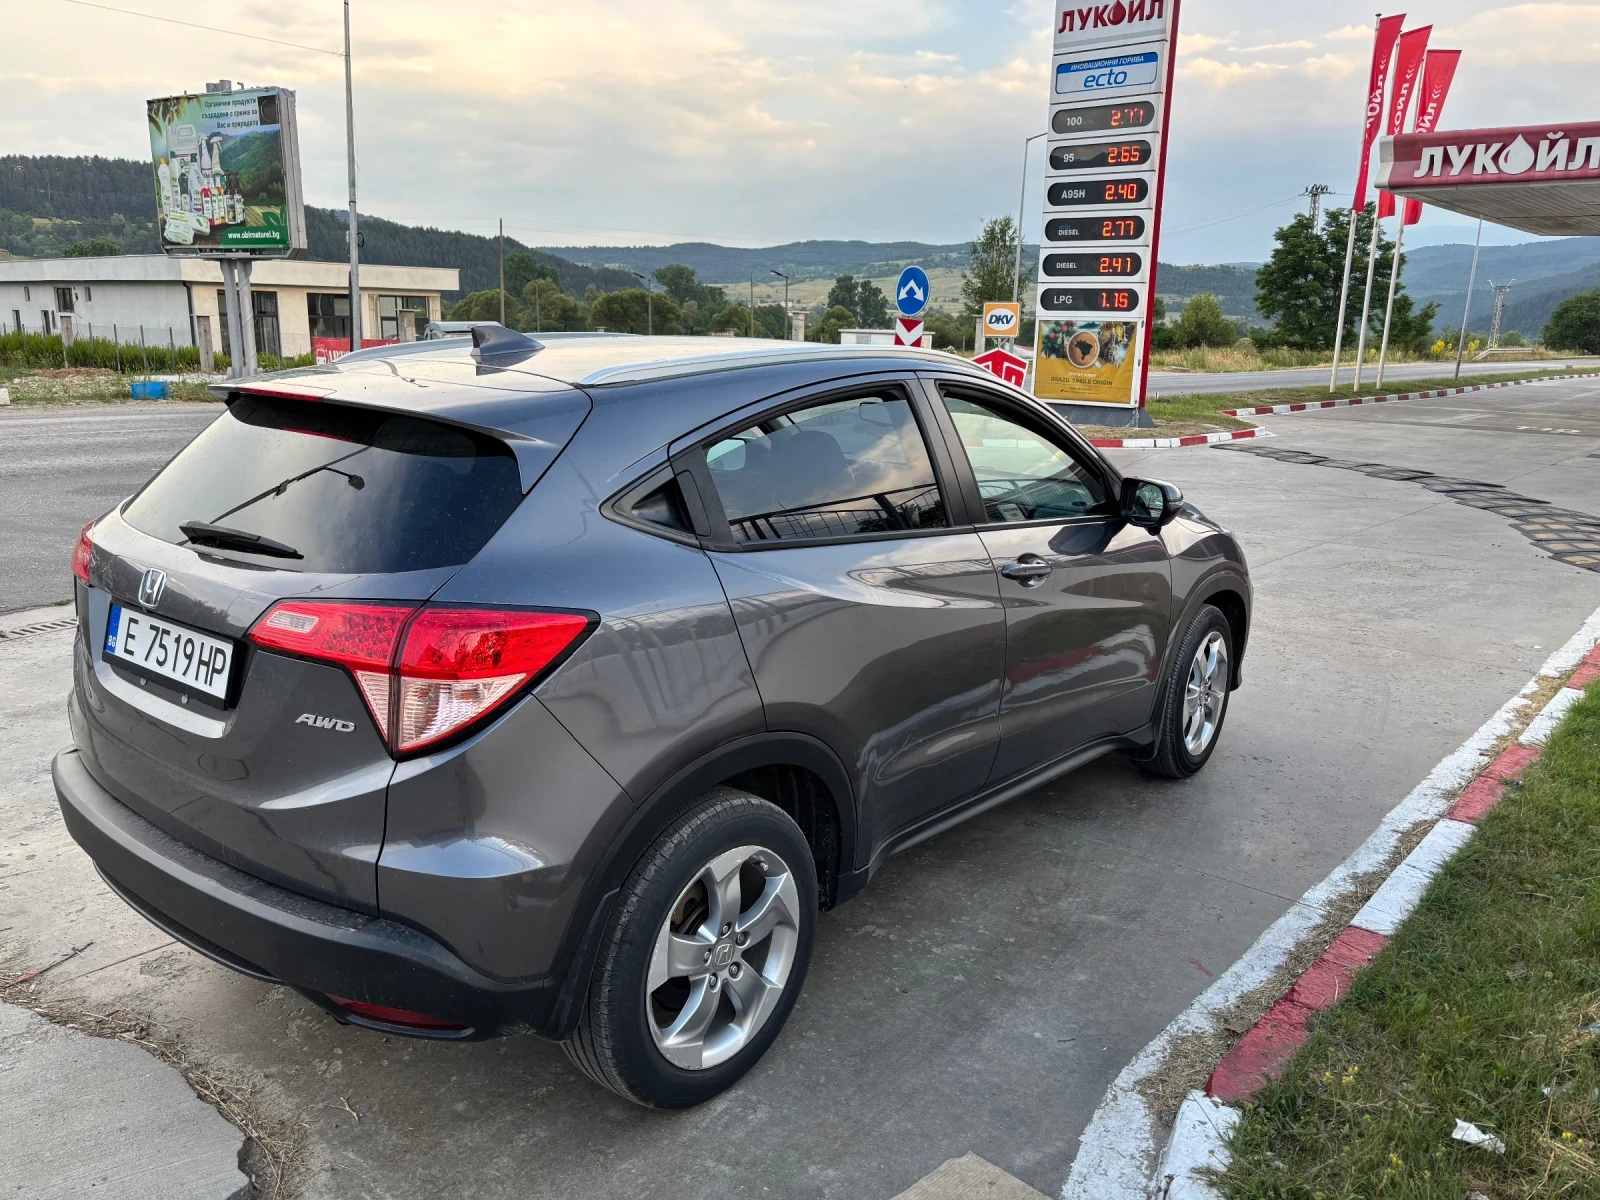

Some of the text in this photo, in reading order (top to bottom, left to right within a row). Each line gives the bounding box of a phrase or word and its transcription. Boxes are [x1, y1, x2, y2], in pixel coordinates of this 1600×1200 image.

[1070, 55, 1145, 71] ИНОВАЦИОННИ ГОРИВА
[1083, 68, 1128, 88] ecto
[204, 98, 257, 109] Органични продукти
[233, 110, 251, 118] грижа
[1066, 116, 1083, 127] 100
[1110, 107, 1145, 126] 2.77
[216, 121, 226, 129] Вас
[231, 120, 259, 129] природата
[1063, 153, 1075, 163] 95
[1107, 145, 1140, 163] 2.65
[1413, 131, 1600, 178] ЛУКОЙЛ
[1061, 183, 1137, 200] A95H 2.40
[1102, 220, 1134, 237] 2.77
[1099, 257, 1131, 273] 2.41
[1053, 292, 1129, 308] LPG 1.15
[988, 314, 1015, 325] DKV
[1071, 377, 1092, 385] SINGLE
[107, 635, 117, 648] BG
[123, 616, 139, 657] E
[294, 713, 356, 733] AWD
